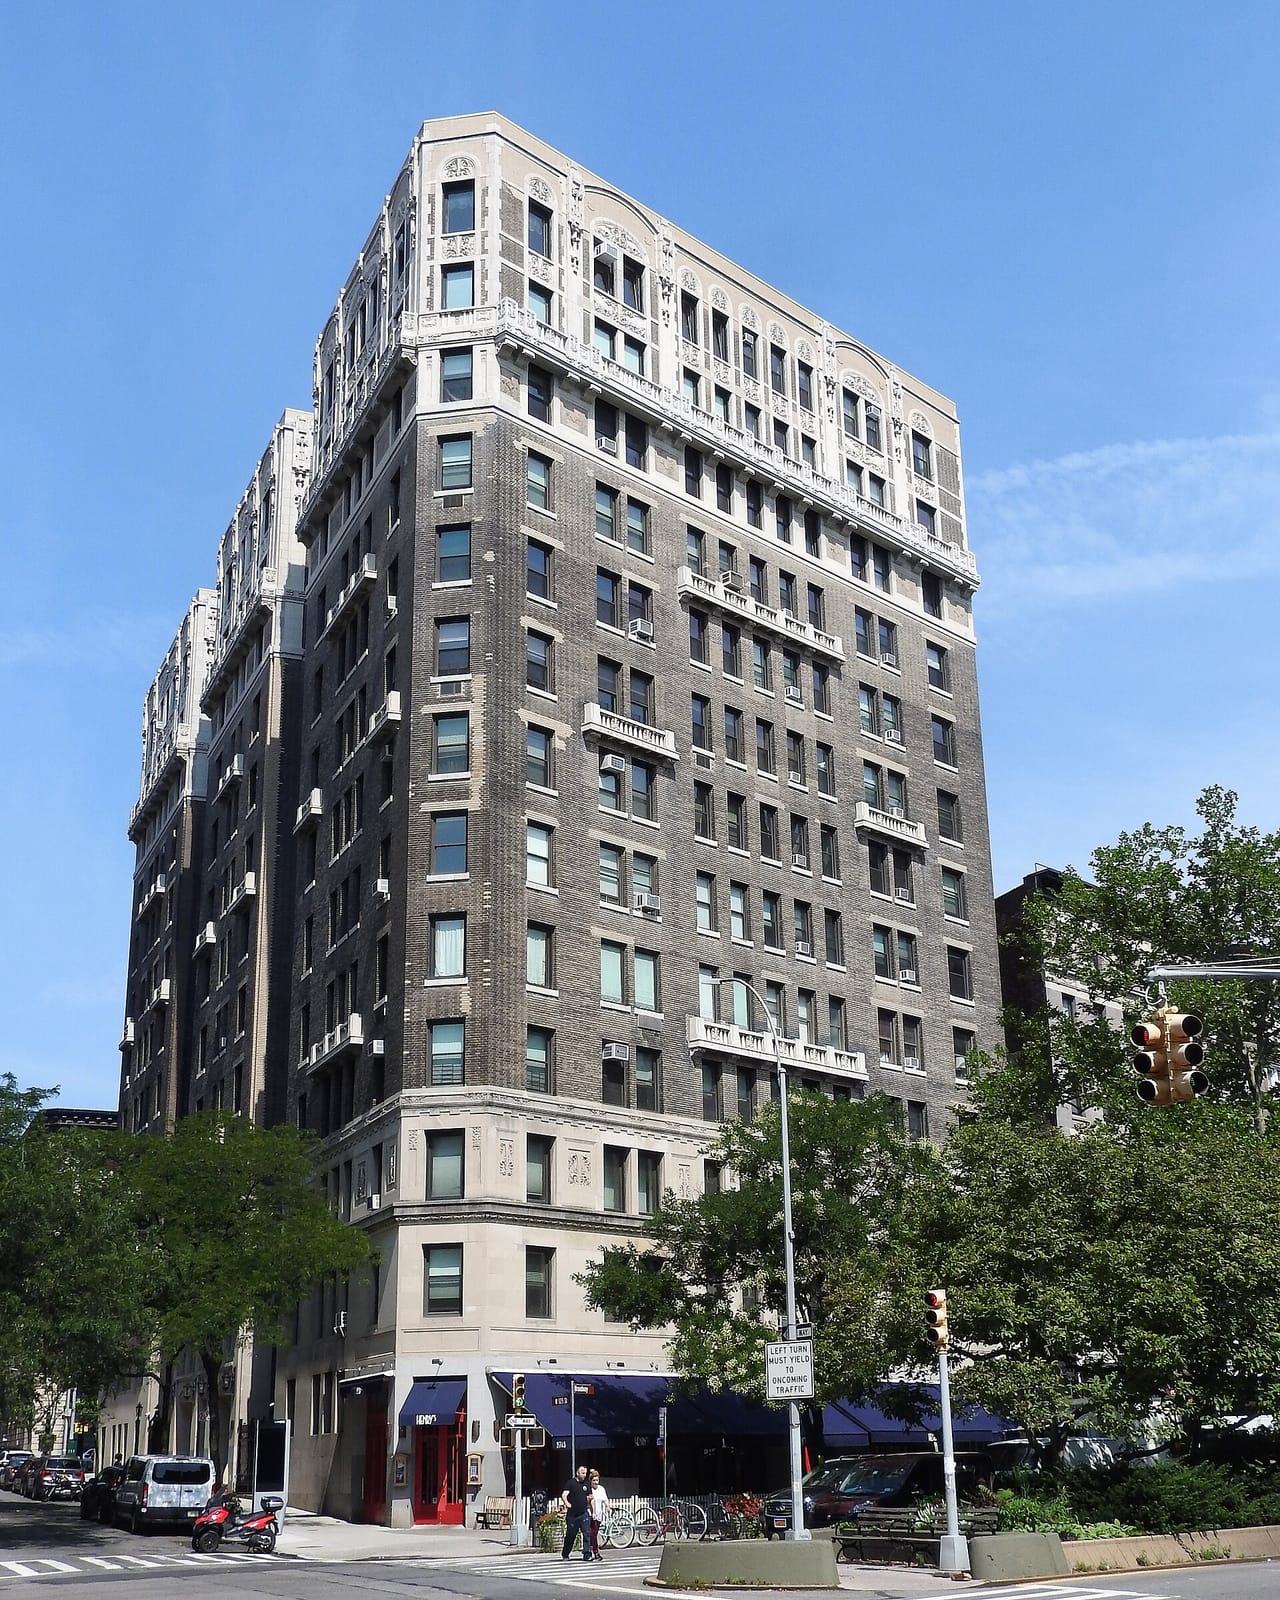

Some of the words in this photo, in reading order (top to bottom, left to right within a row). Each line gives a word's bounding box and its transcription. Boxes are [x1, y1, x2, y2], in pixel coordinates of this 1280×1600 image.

[770, 1347, 787, 1355] LEFT
[790, 1345, 808, 1354] TURN
[769, 1356, 787, 1364] MUST
[790, 1355, 810, 1364] YIELD
[786, 1366, 794, 1374] TO
[772, 1375, 808, 1385] ONCOMING
[776, 1385, 805, 1394] TRAFFIC
